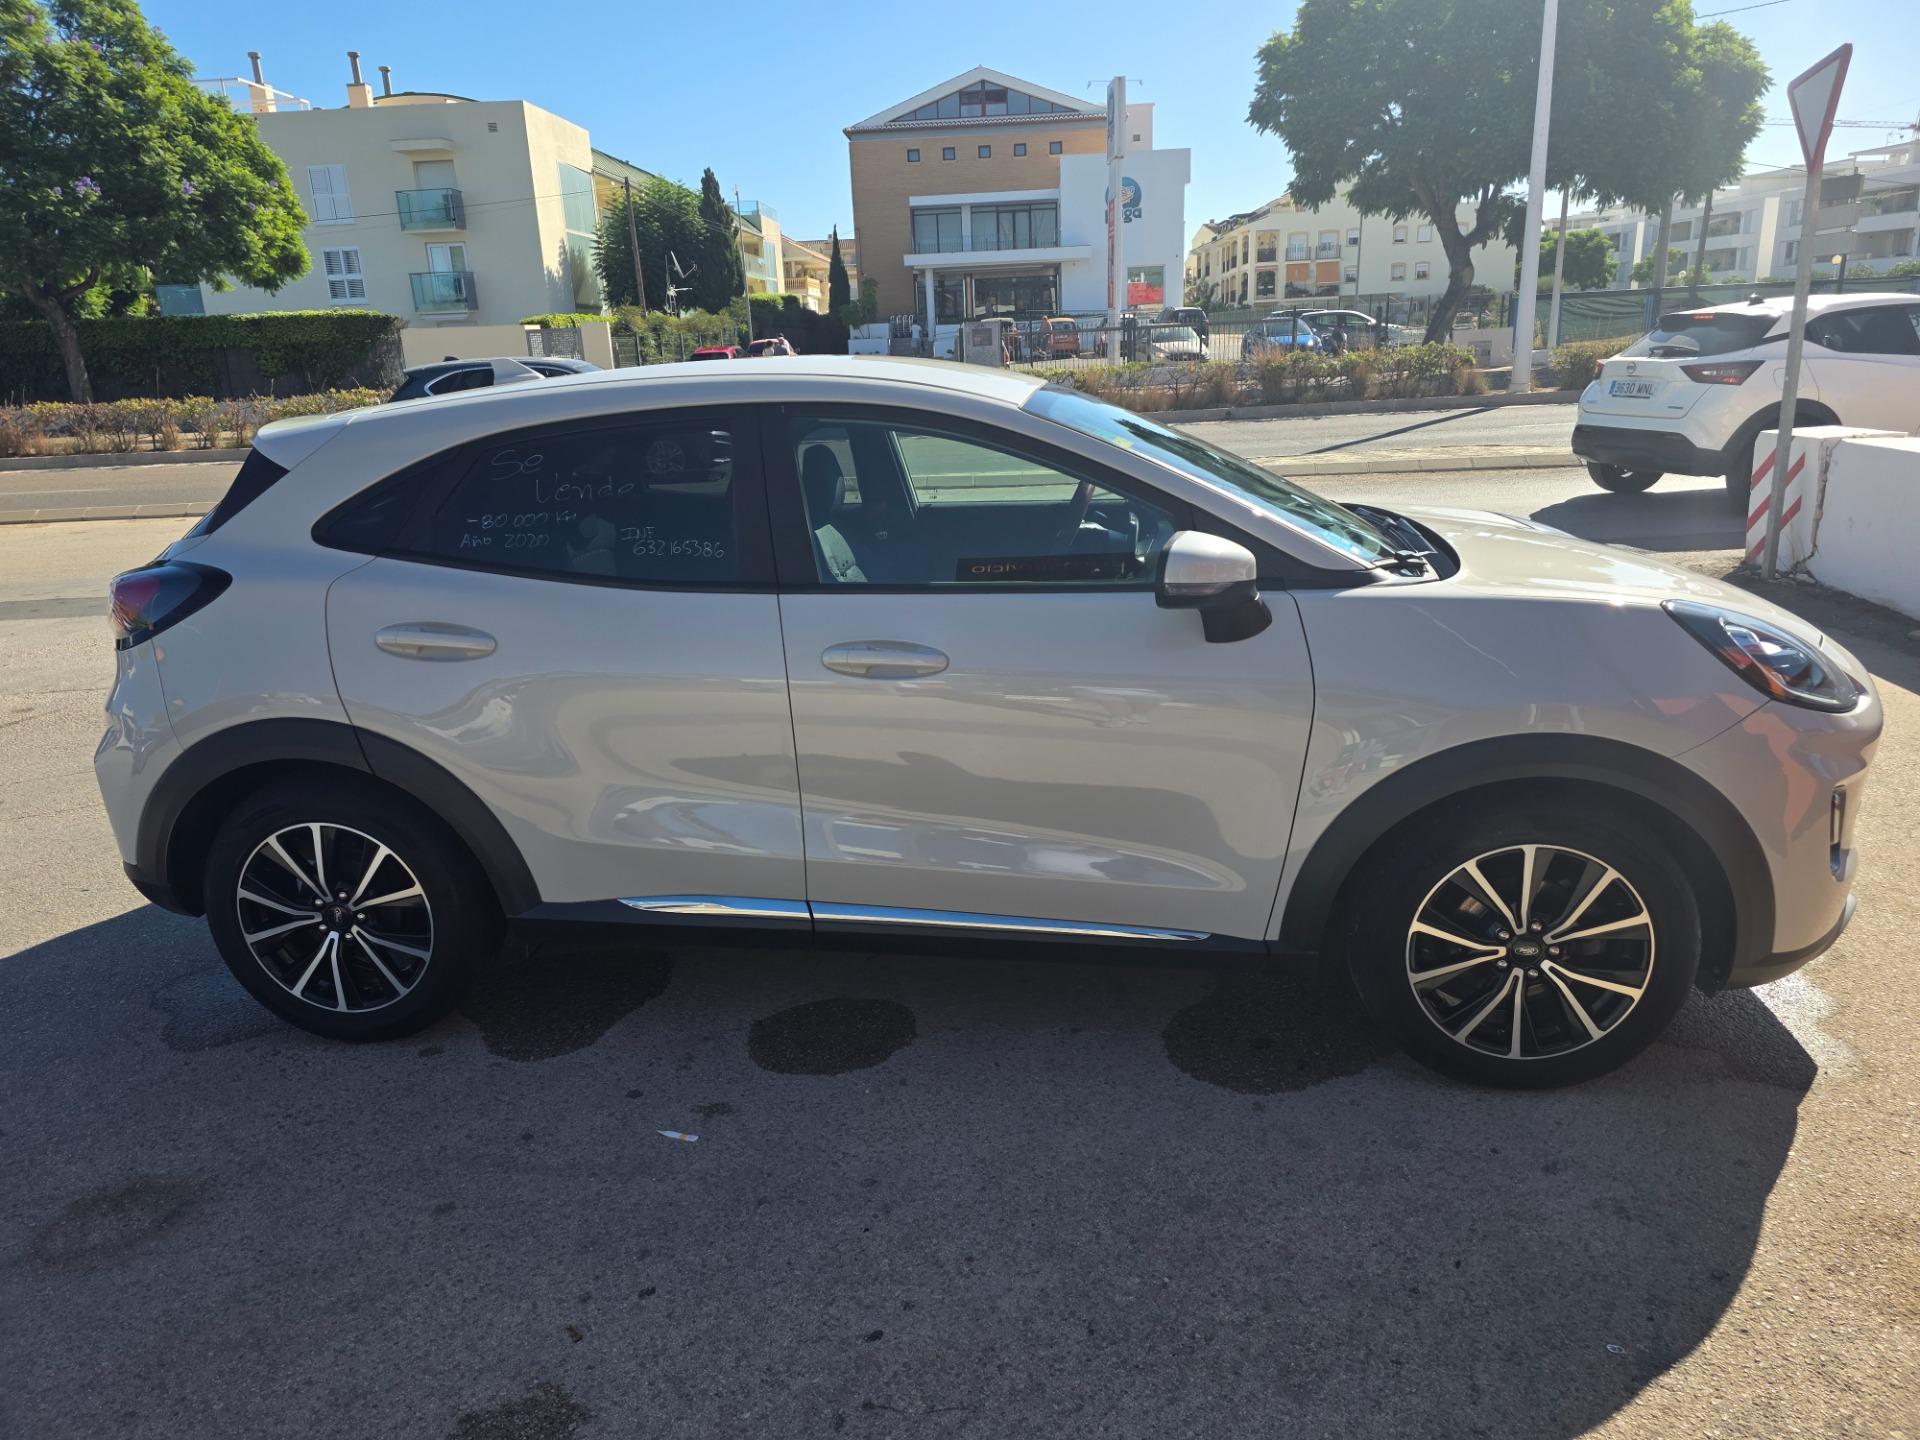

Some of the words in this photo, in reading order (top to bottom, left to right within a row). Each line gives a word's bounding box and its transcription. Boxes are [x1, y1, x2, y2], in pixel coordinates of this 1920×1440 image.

[1636, 383, 1653, 395] MNL
[490, 449, 544, 481] Se
[460, 533, 492, 548] Año
